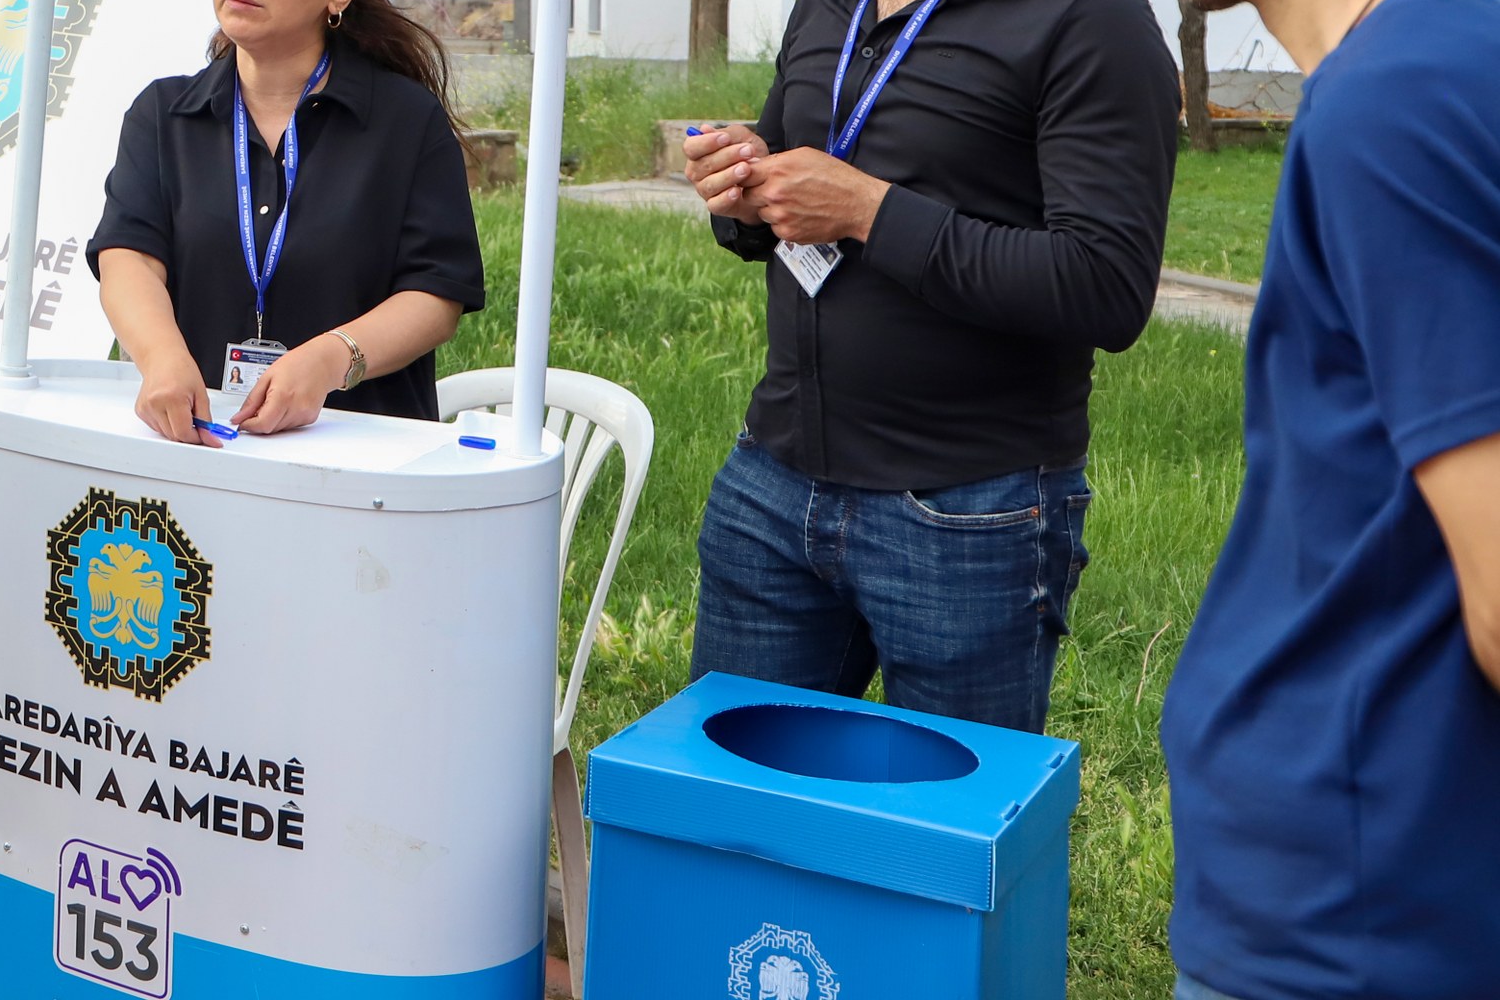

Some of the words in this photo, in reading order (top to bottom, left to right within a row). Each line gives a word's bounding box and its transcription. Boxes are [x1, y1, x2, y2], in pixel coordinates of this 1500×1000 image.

[169, 738, 305, 796] BAJARÊ
[95, 767, 127, 809] A
[138, 778, 305, 850] AMEDÊ
[67, 903, 159, 981] 153
